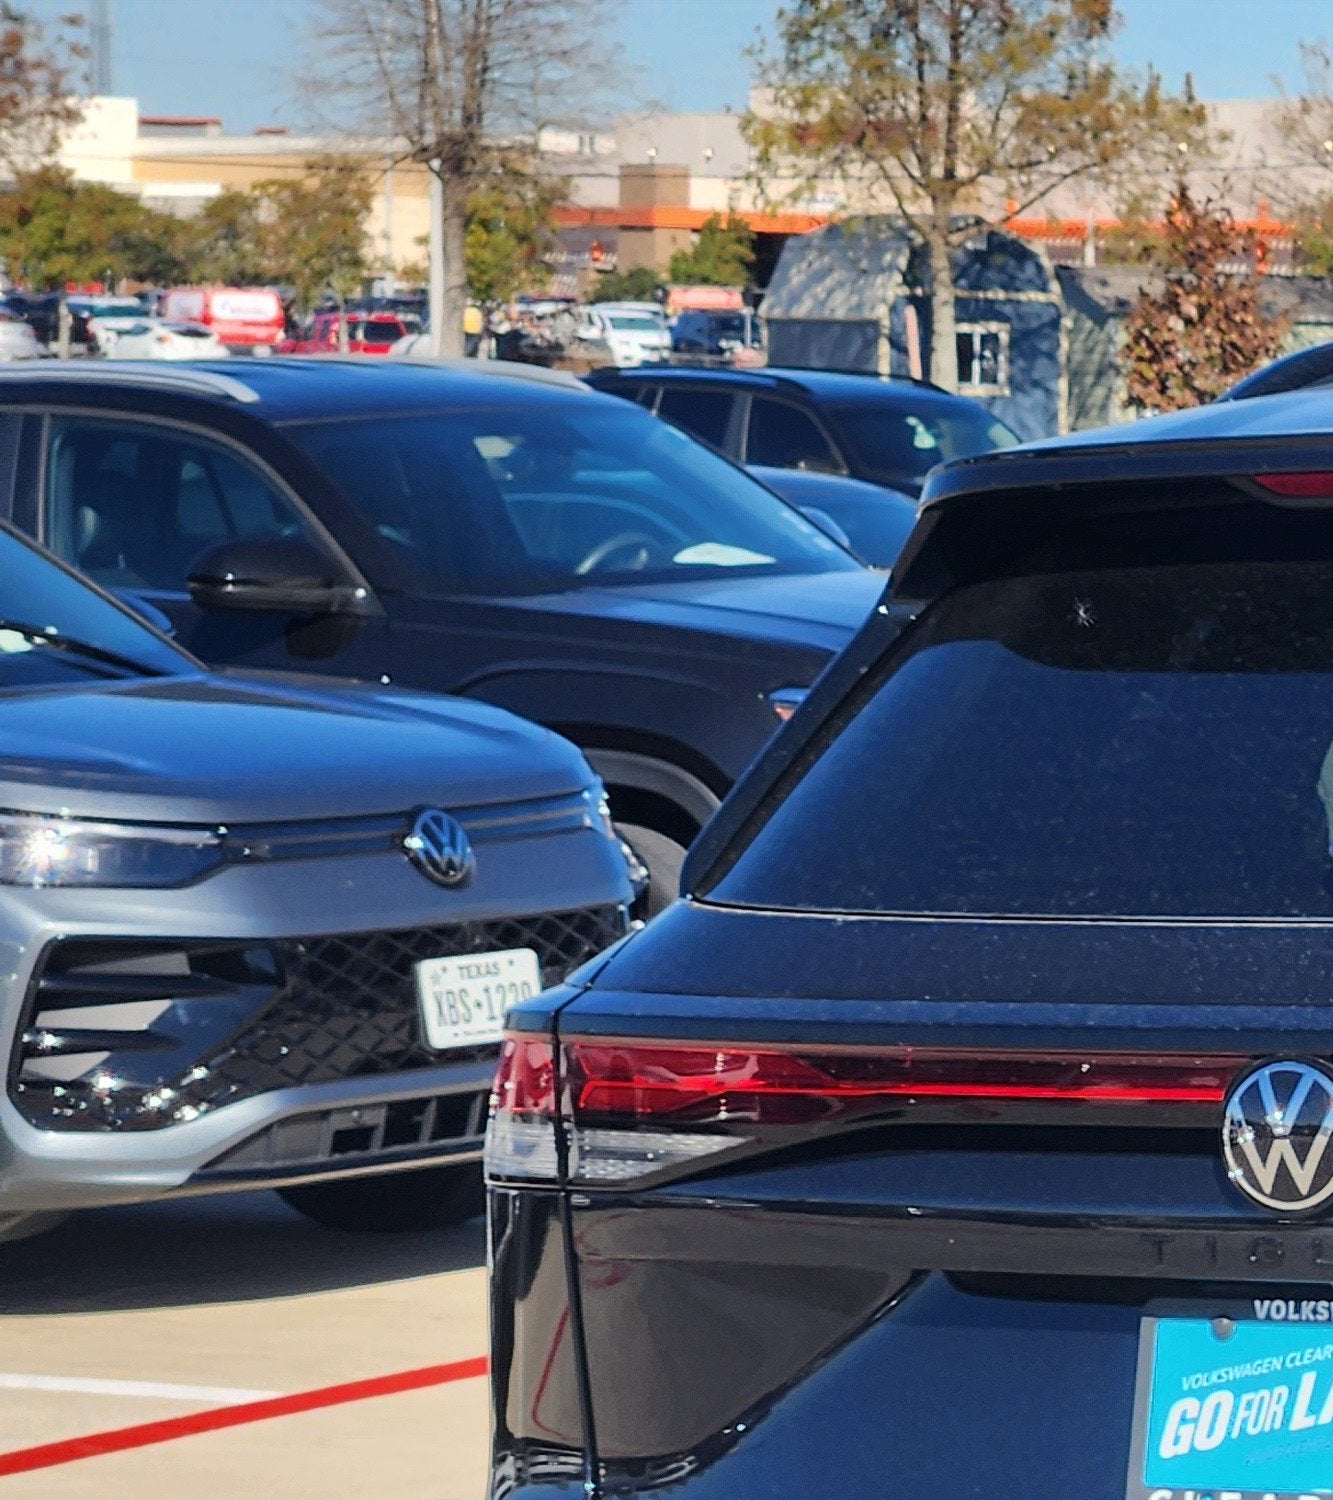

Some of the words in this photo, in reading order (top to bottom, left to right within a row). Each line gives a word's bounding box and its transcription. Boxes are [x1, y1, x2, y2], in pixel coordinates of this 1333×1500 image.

[457, 960, 500, 980] TEXAS
[1181, 1355, 1284, 1391] VOLKSWAGEN
[1159, 1391, 1235, 1459] GO
[1231, 1384, 1290, 1439] FOR
